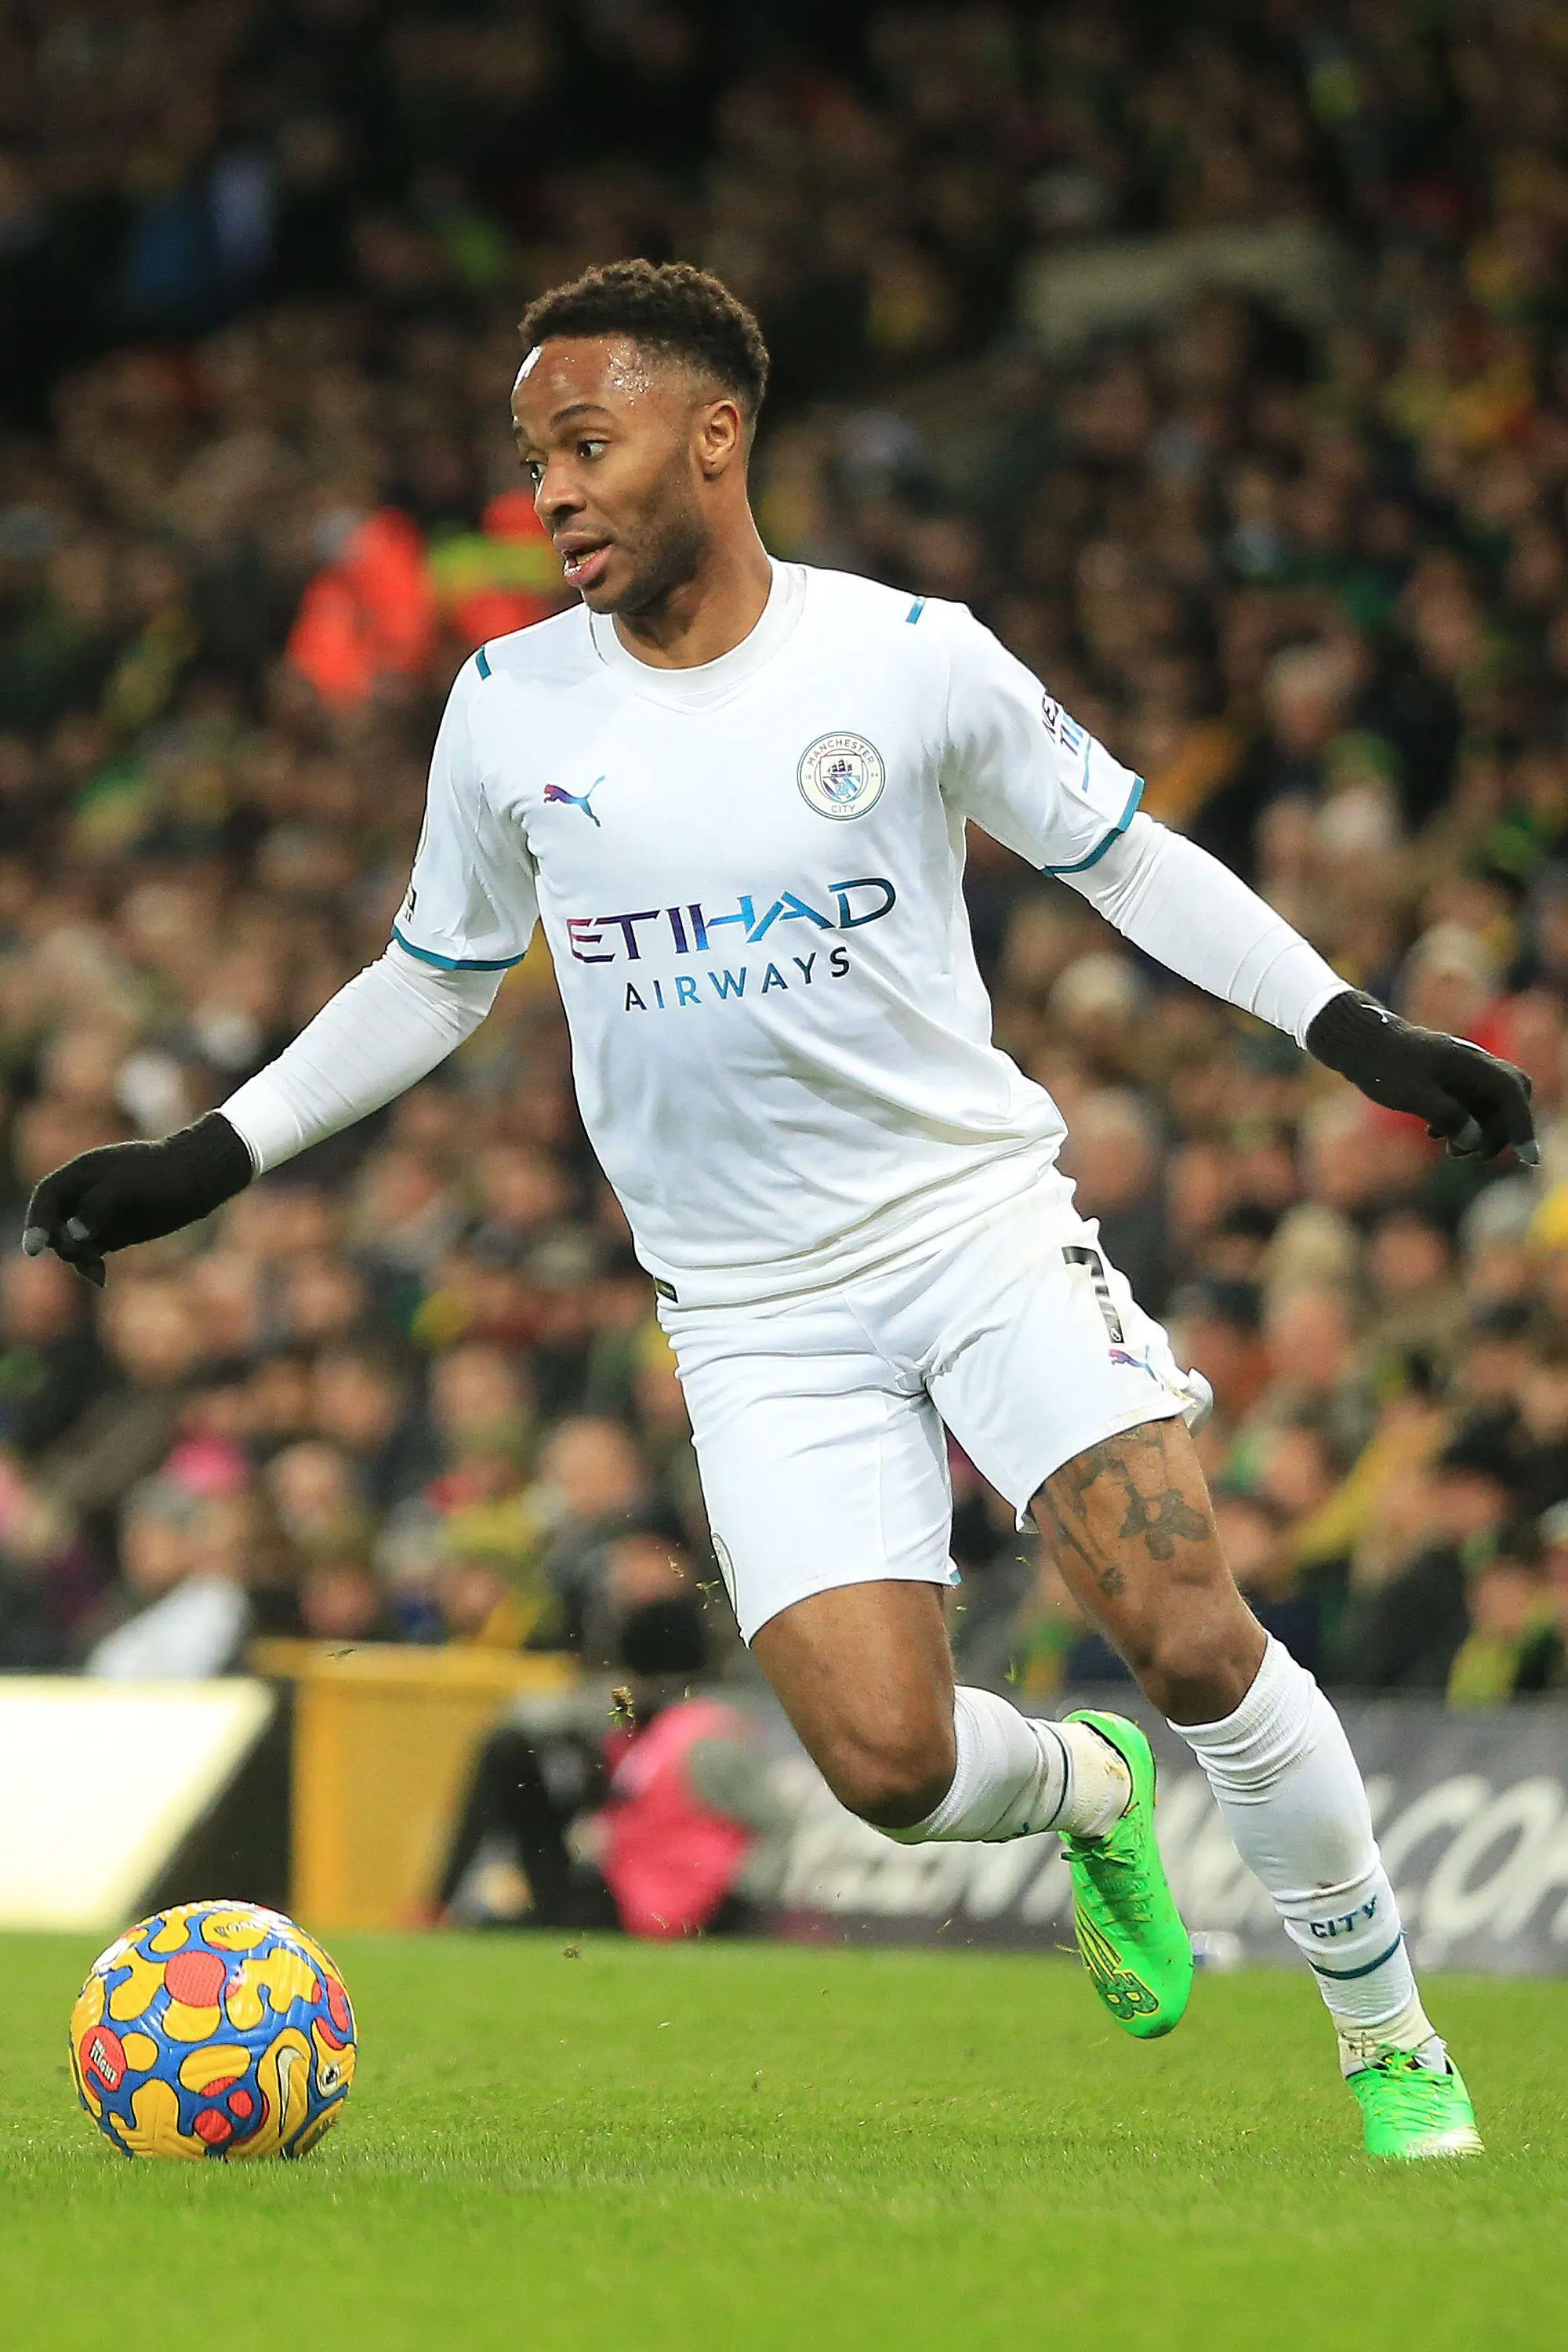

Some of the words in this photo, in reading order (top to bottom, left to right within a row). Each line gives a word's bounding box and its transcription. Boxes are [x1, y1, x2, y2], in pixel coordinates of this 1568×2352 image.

[807, 739, 874, 765] MANCHESTER
[831, 804, 855, 814] CITY
[566, 877, 896, 963] ETIHAD
[625, 946, 850, 1011] AIRWAYS
[1310, 1894, 1377, 1938] CITY
